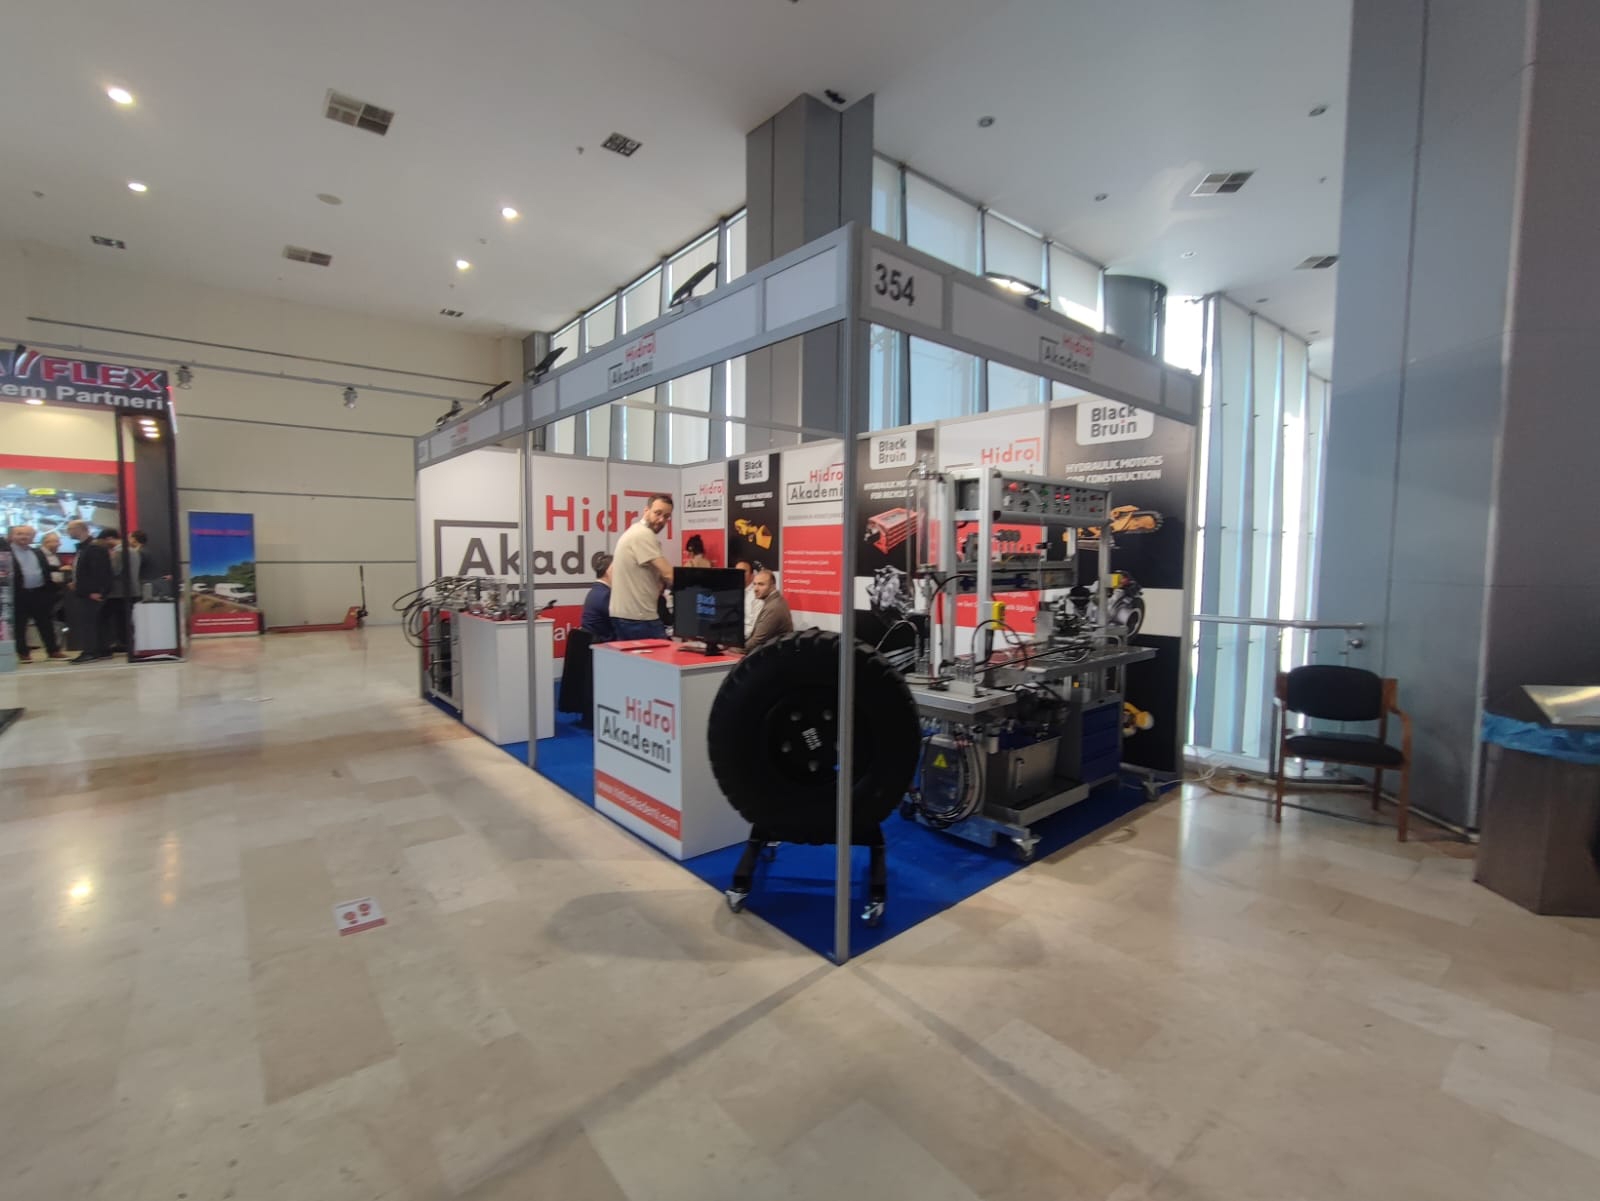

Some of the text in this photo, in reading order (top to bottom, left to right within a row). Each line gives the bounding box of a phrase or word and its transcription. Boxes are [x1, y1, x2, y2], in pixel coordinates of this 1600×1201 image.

[875, 263, 915, 307] 354
[0, 383, 164, 410] em Partneri
[1091, 403, 1137, 422] Black
[1090, 419, 1137, 438] Bruin
[879, 438, 906, 452] Black
[981, 442, 1034, 465] Hidro
[879, 450, 906, 464] Bruin
[809, 466, 843, 483] Hidro
[790, 483, 844, 500] Akademi
[545, 494, 642, 533] Hidr
[625, 695, 670, 734] Hidro
[602, 715, 671, 764] Akademi
